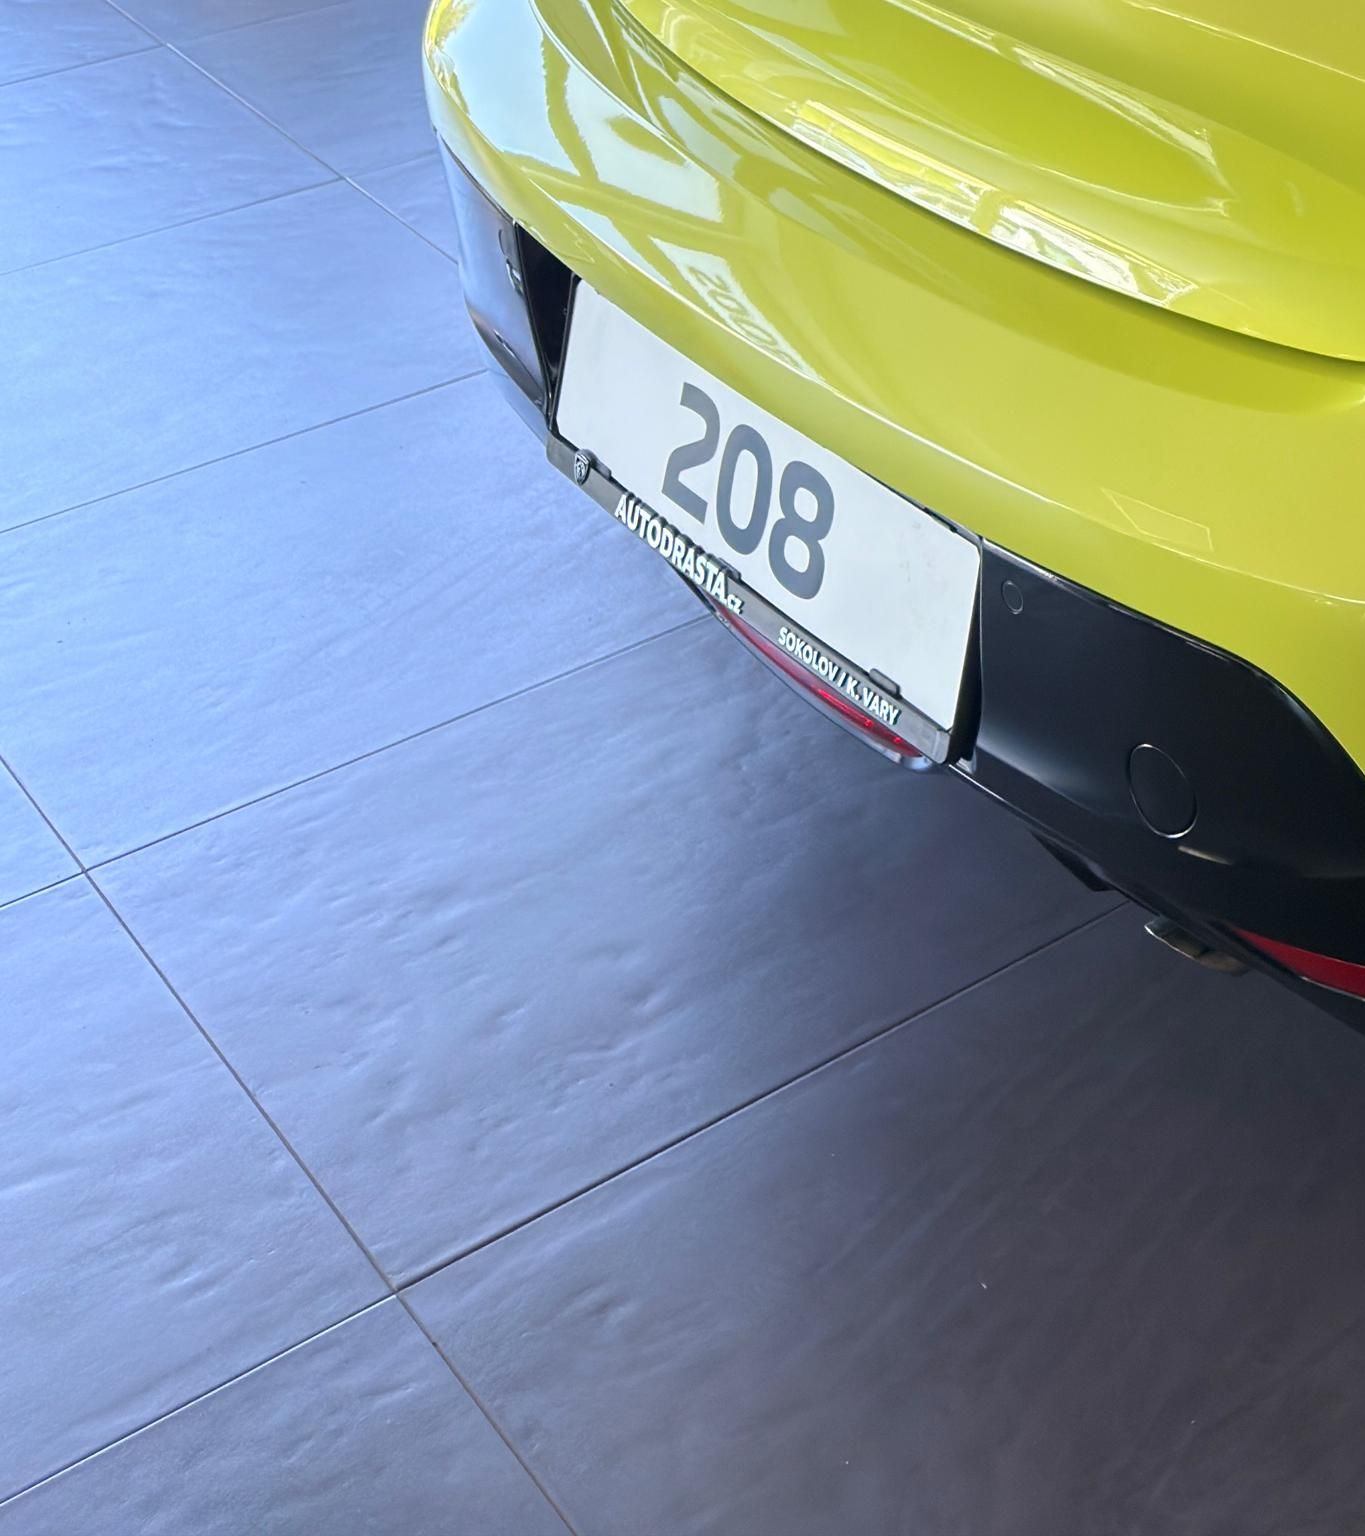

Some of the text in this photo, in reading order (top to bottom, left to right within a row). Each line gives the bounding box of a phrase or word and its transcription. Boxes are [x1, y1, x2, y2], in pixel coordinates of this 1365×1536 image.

[661, 381, 835, 601] 208
[778, 626, 840, 683] SOKOLOV
[846, 675, 861, 701] K.
[862, 686, 901, 726] VARY
